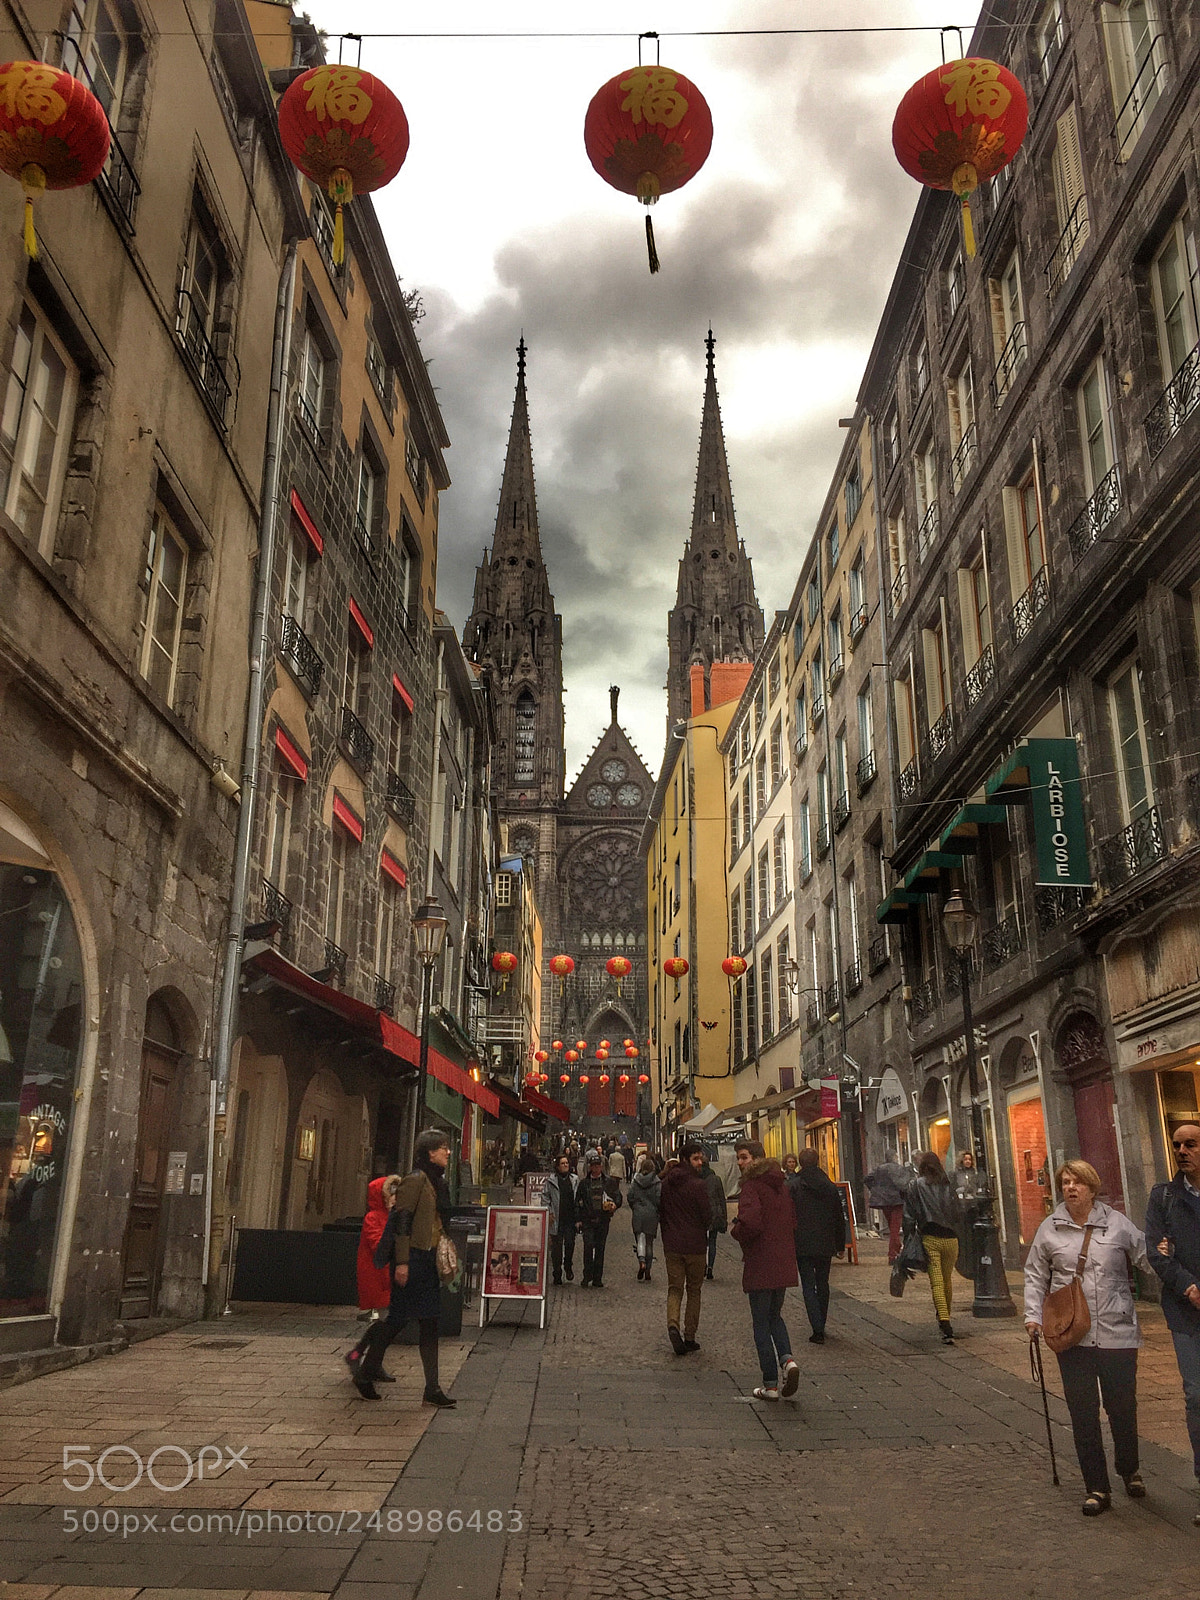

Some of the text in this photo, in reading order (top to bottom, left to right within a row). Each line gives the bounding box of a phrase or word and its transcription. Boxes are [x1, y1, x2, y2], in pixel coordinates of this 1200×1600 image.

[0, 61, 67, 125] 福
[303, 64, 373, 125] 福
[620, 65, 689, 129] 福
[941, 58, 1012, 119] 福
[1047, 761, 1071, 877] LARBIOSE
